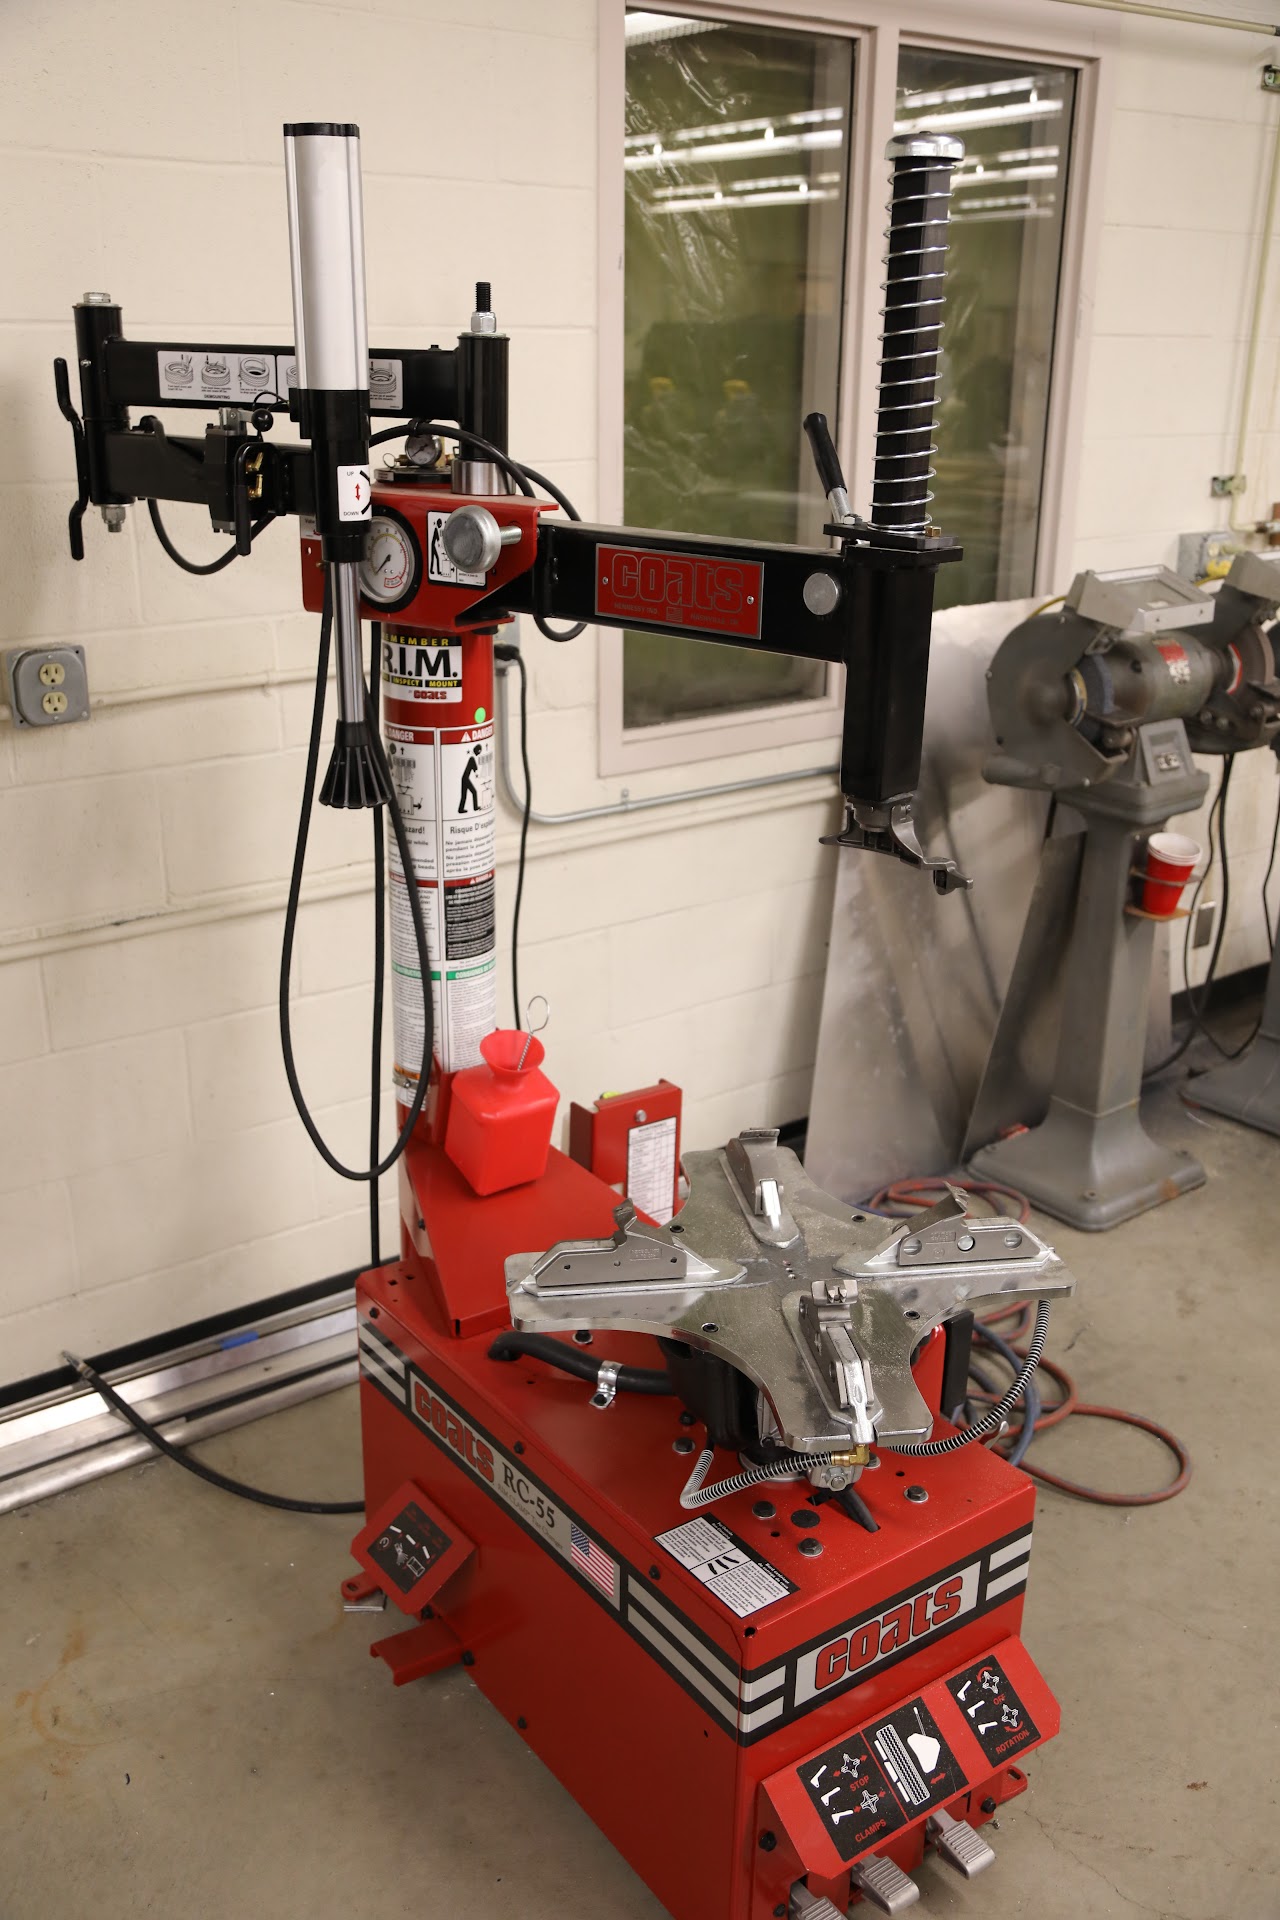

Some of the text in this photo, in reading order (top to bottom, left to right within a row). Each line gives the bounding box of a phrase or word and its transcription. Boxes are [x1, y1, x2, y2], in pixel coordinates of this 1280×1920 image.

[393, 677, 458, 688] INSPECT MOUNT
[387, 728, 414, 743] DANGER
[450, 826, 473, 835] Risque
[502, 1462, 555, 1528] RC-55
[993, 1693, 1006, 1706] OFF
[996, 1730, 1030, 1755] ROTATION
[850, 1775, 870, 1792] STOP
[855, 1819, 887, 1843] CLAMPS
